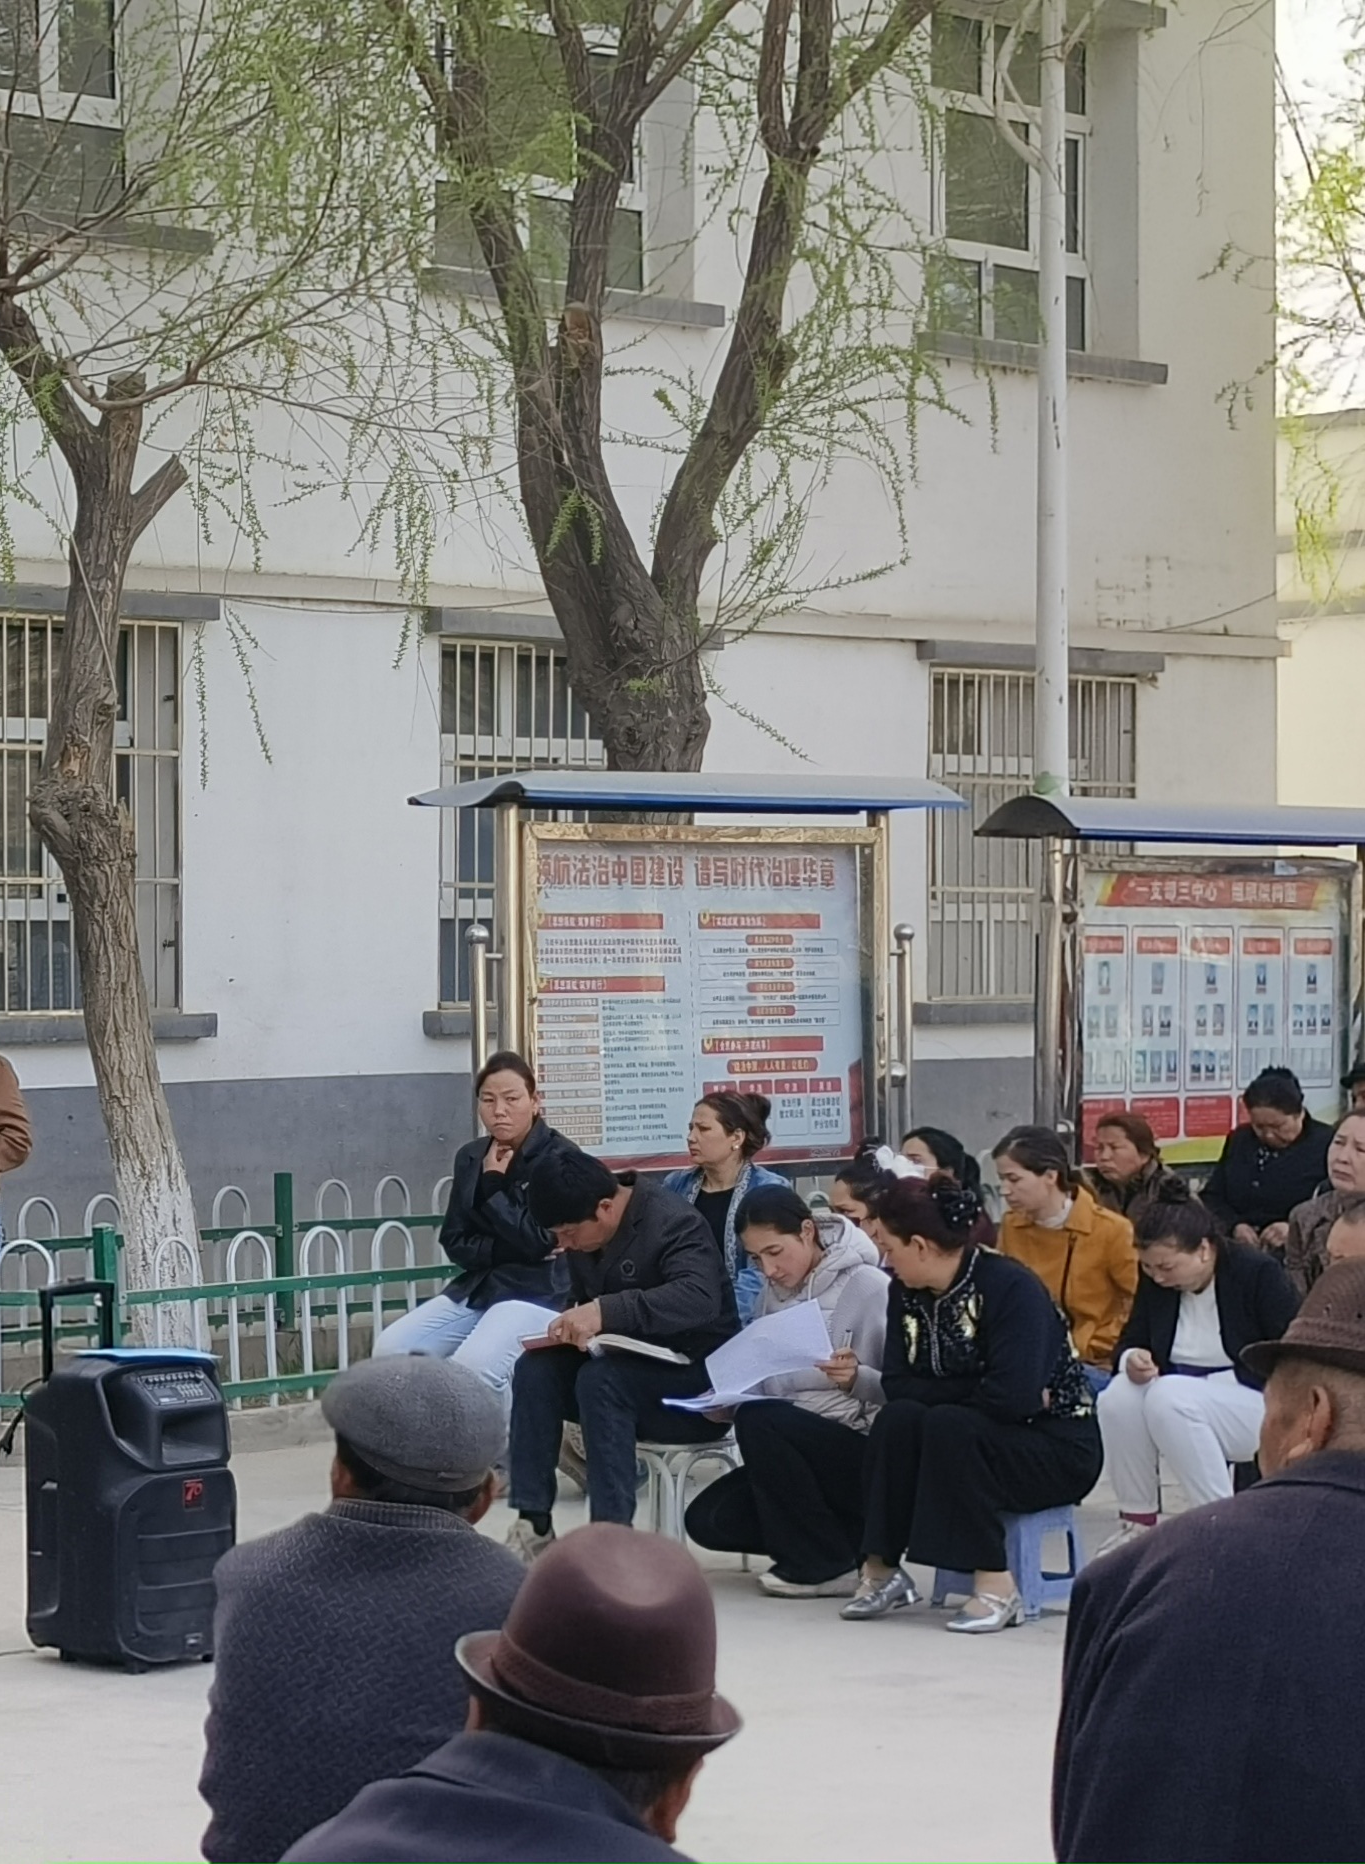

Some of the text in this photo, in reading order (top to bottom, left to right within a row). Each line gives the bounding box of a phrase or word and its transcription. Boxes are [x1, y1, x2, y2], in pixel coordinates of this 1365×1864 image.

[694, 856, 835, 887] 谱写时代治理华章
